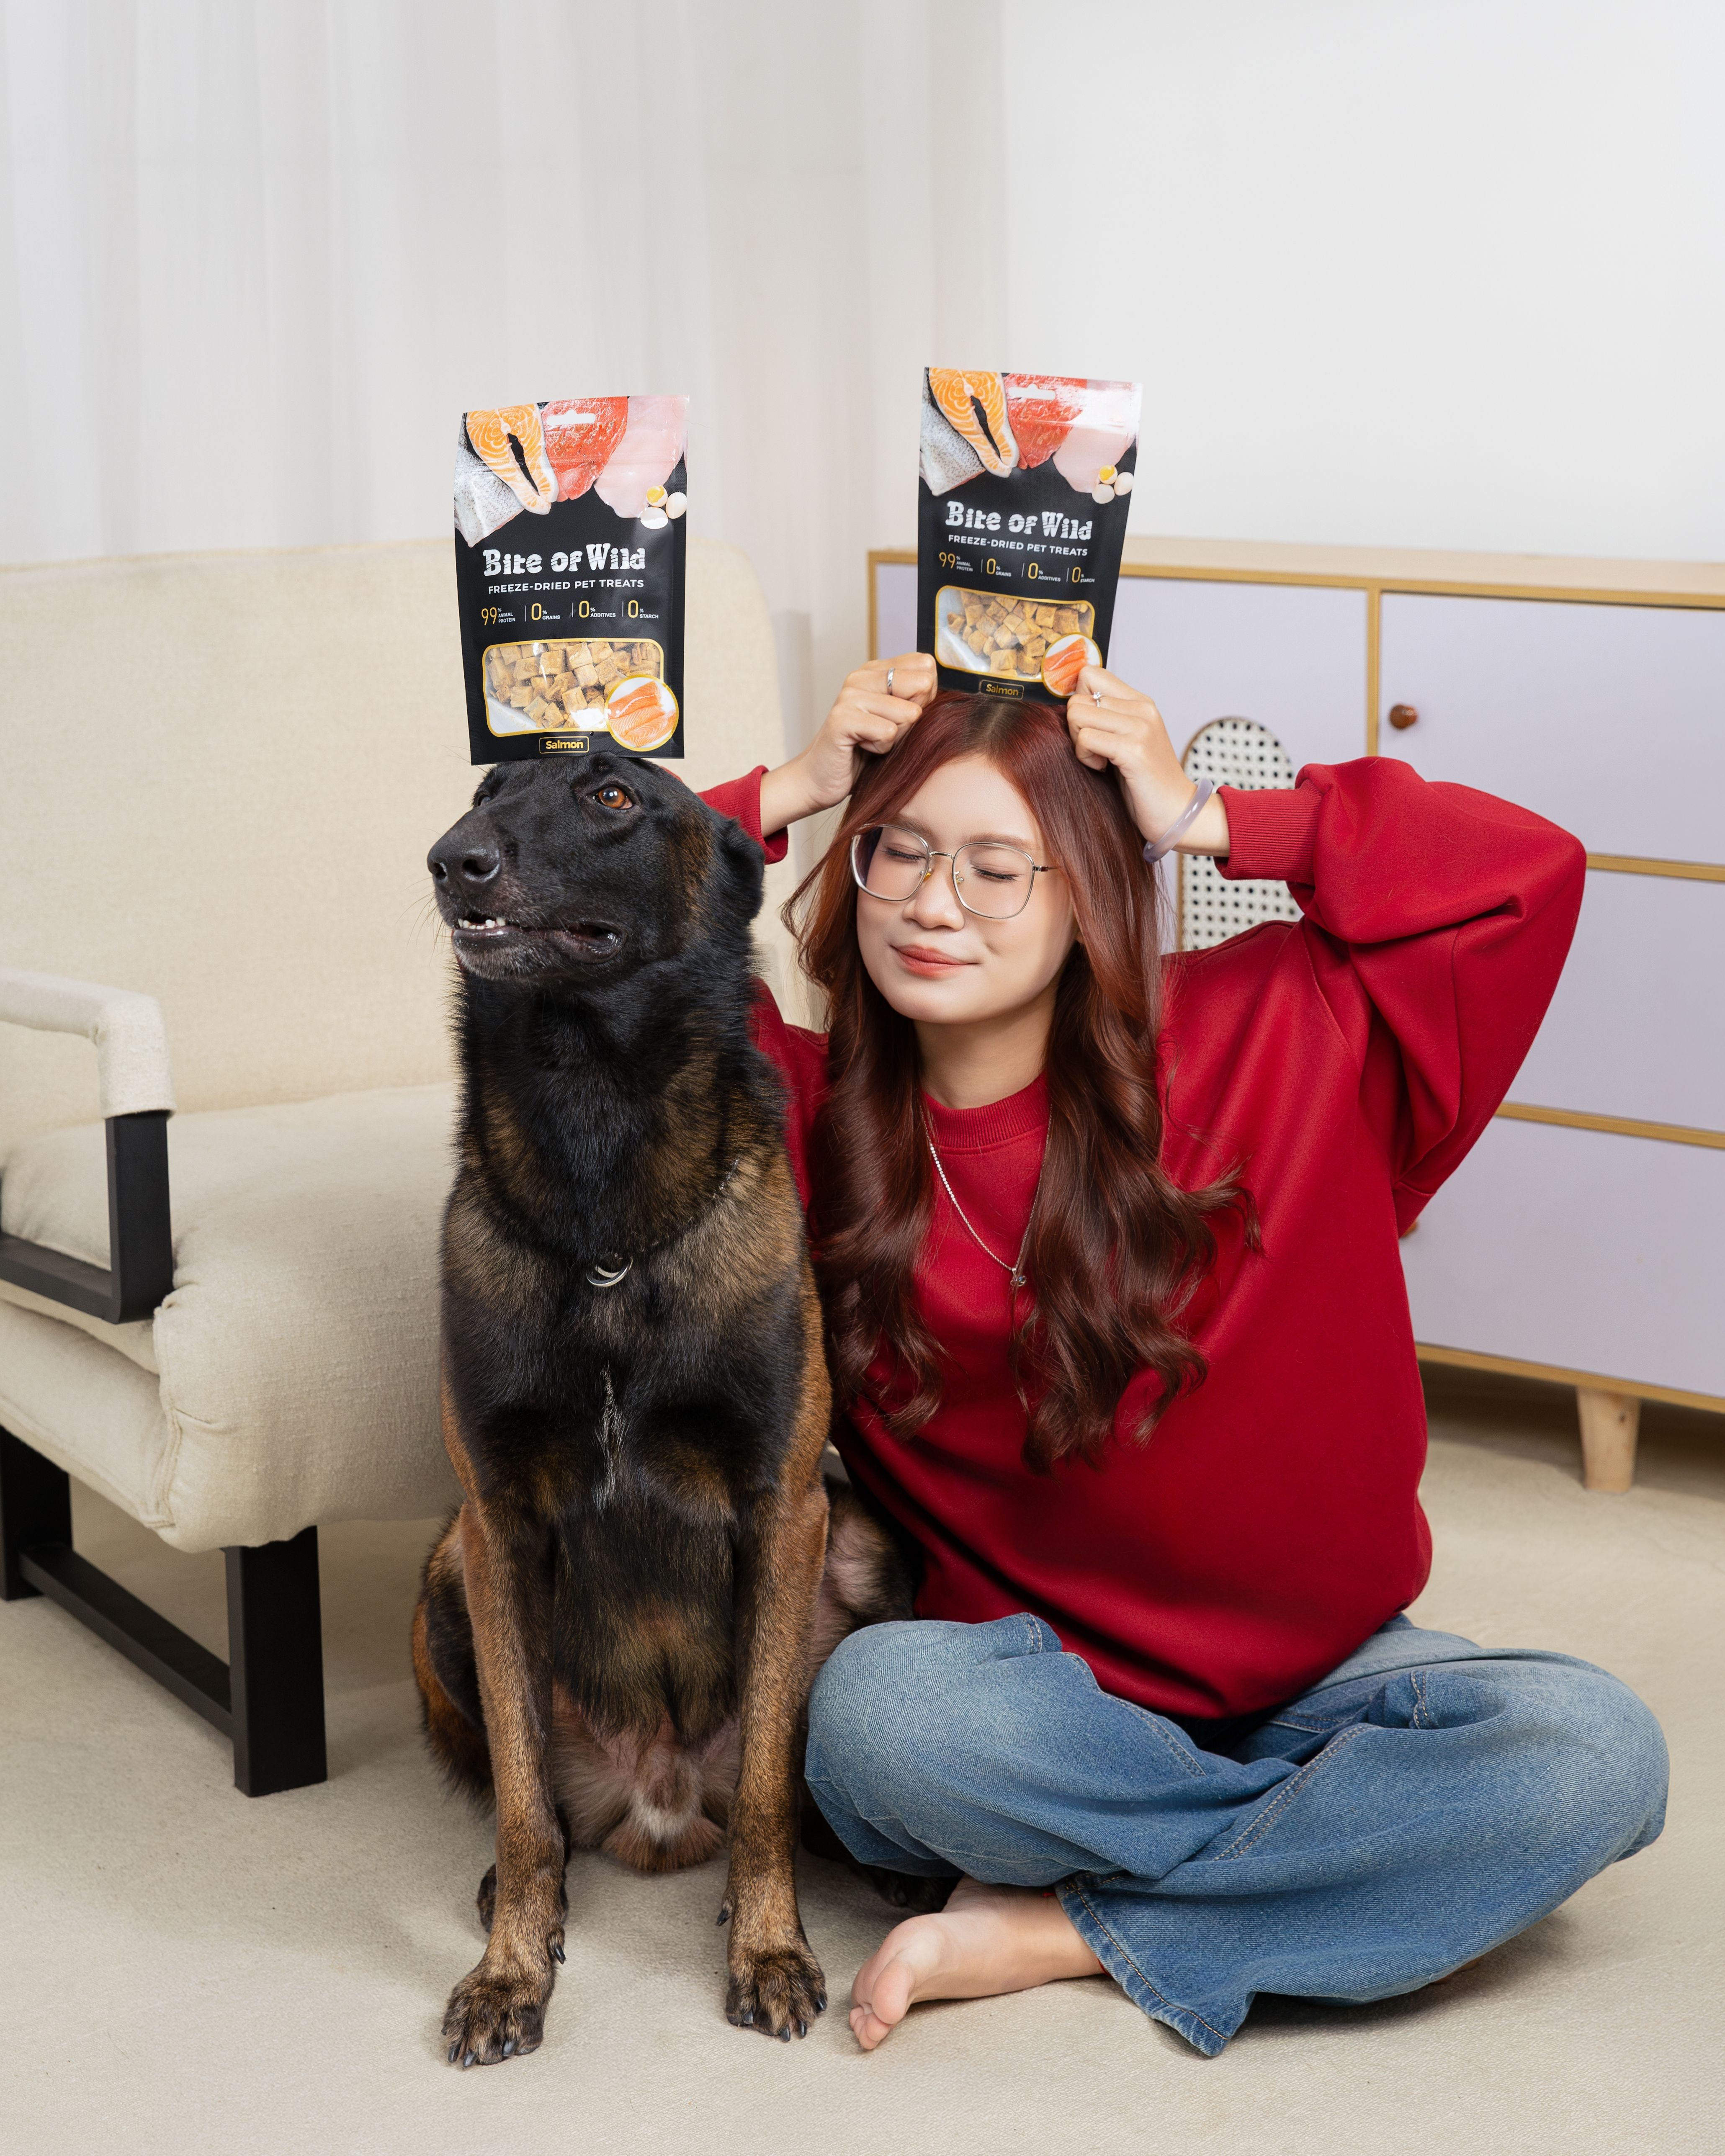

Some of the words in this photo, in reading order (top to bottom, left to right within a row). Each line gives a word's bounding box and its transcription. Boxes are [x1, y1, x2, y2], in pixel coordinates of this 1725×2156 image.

[945, 501, 1001, 531] Bite
[1008, 514, 1038, 535] of
[1041, 511, 1093, 540] Wild
[948, 535, 1024, 550] FREEZE-DRIED
[1027, 544, 1047, 553] PET
[1049, 545, 1088, 556] TREATS
[483, 549, 542, 576] Bite
[551, 551, 583, 572] of
[586, 543, 646, 571] Wild
[488, 581, 570, 594] FREEZE-DRIED
[575, 580, 596, 589] PET
[599, 579, 644, 588] TREATS
[986, 684, 1018, 696] Salmon
[546, 740, 584, 749] Salmon
